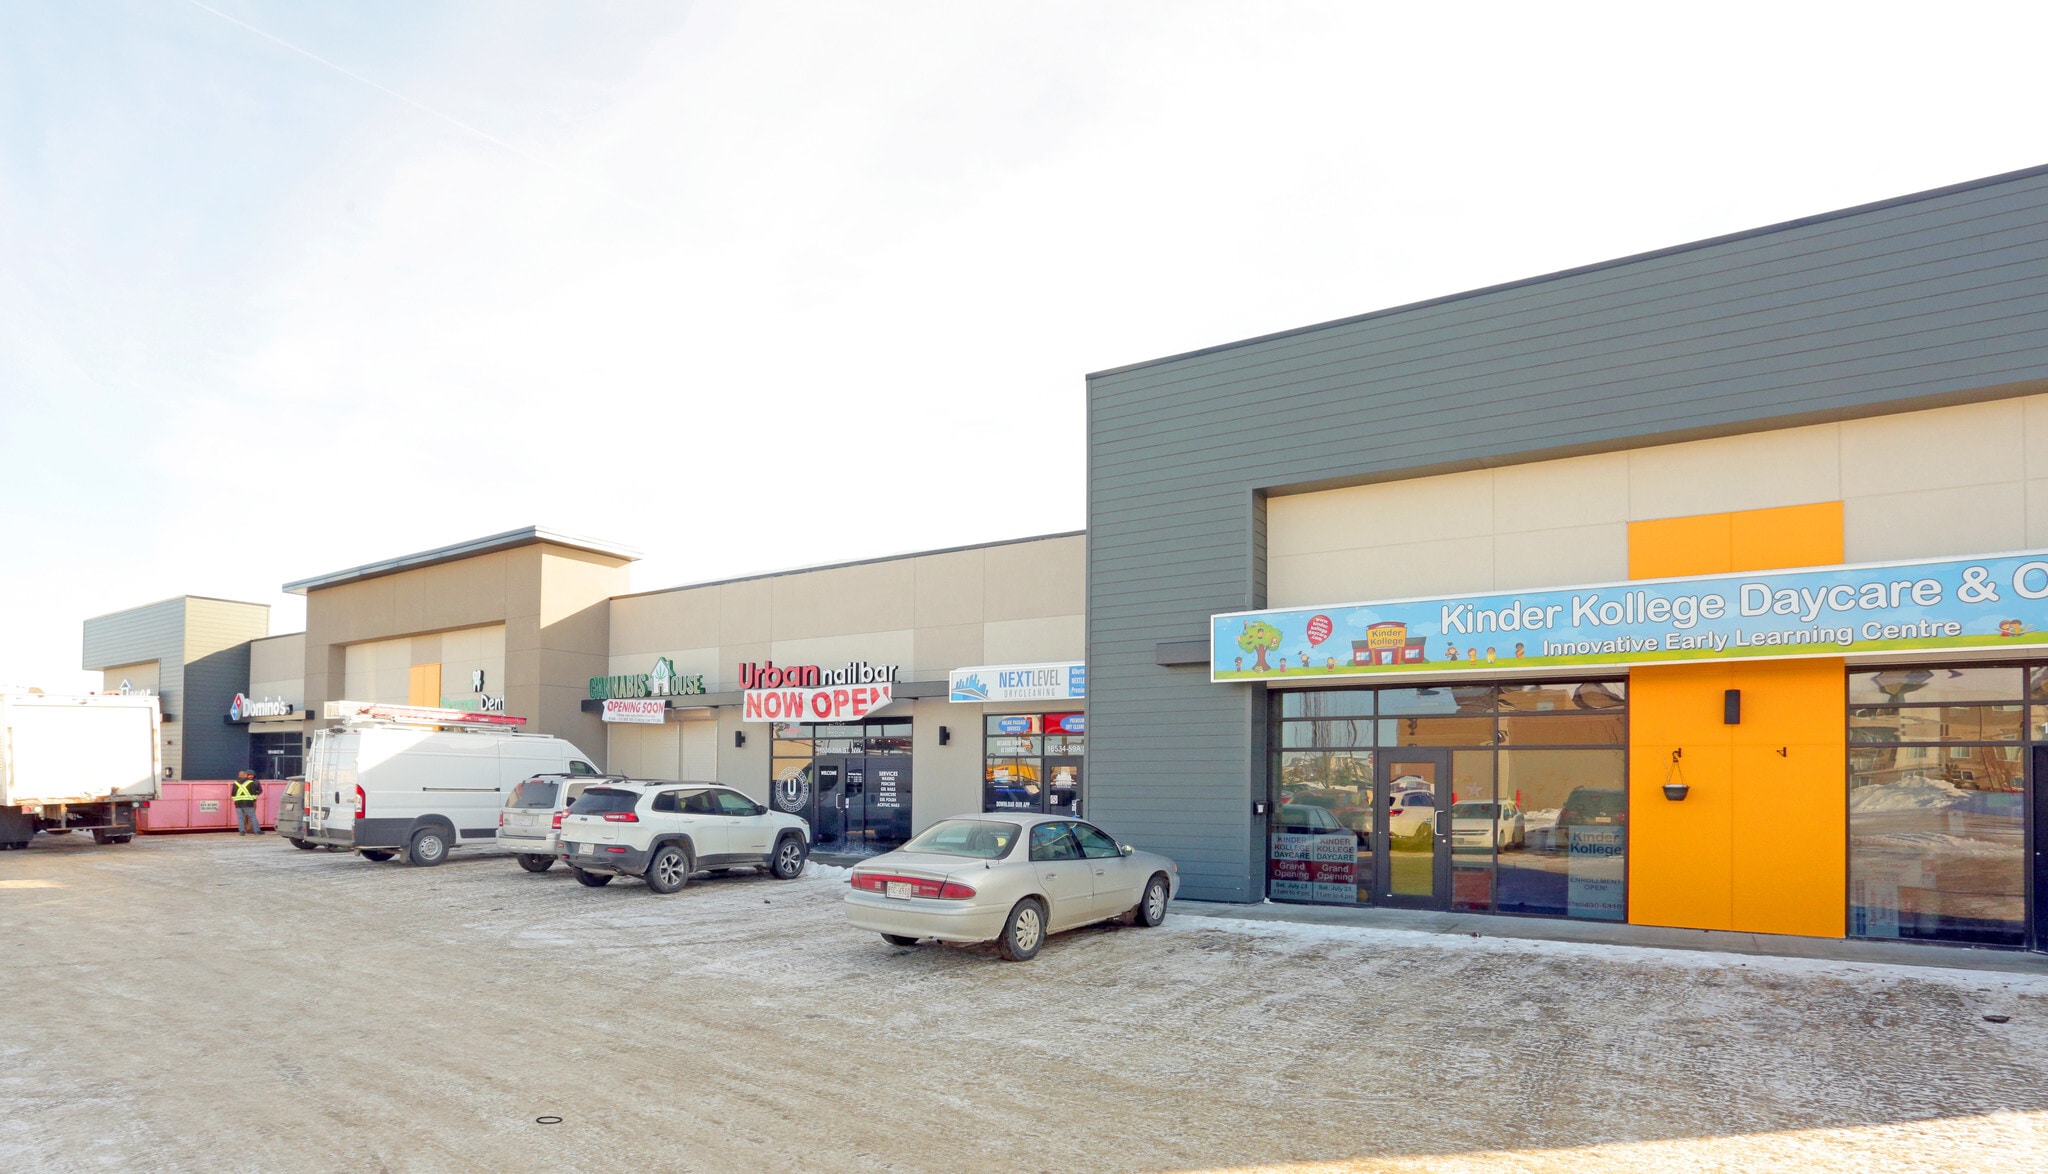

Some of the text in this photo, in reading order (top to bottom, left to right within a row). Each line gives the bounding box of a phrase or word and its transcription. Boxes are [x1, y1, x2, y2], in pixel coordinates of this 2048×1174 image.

[1440, 600, 1563, 635] Kinder
[1571, 591, 1726, 630] Kollege
[1739, 578, 1943, 623] Daycare
[1956, 565, 2000, 603] &
[1371, 630, 1402, 638] Kinder
[1543, 618, 1962, 657] Innovative Early Learning Centre
[1370, 638, 1404, 646] Kollege
[738, 660, 898, 689] Urban nail bar
[589, 674, 650, 700] CANNABIS
[1004, 687, 1056, 698] DRYCLEANING
[242, 696, 287, 717] Domino's
[607, 701, 665, 714] OPENING SOON
[746, 692, 804, 718] NOW
[786, 778, 797, 796] U
[1573, 831, 1619, 843] Kinder
[1274, 844, 1310, 852] KOLLEGE
[1570, 843, 1622, 856] Kollege
[1274, 851, 1311, 859] DAYCARE
[1316, 853, 1355, 861] DAYCARE
[1279, 862, 1305, 870] Grand
[1321, 864, 1349, 873] Grand
[1274, 870, 1310, 880] Opening
[1316, 871, 1354, 882] Opening
[1570, 876, 1621, 885] ENROLLMENT
